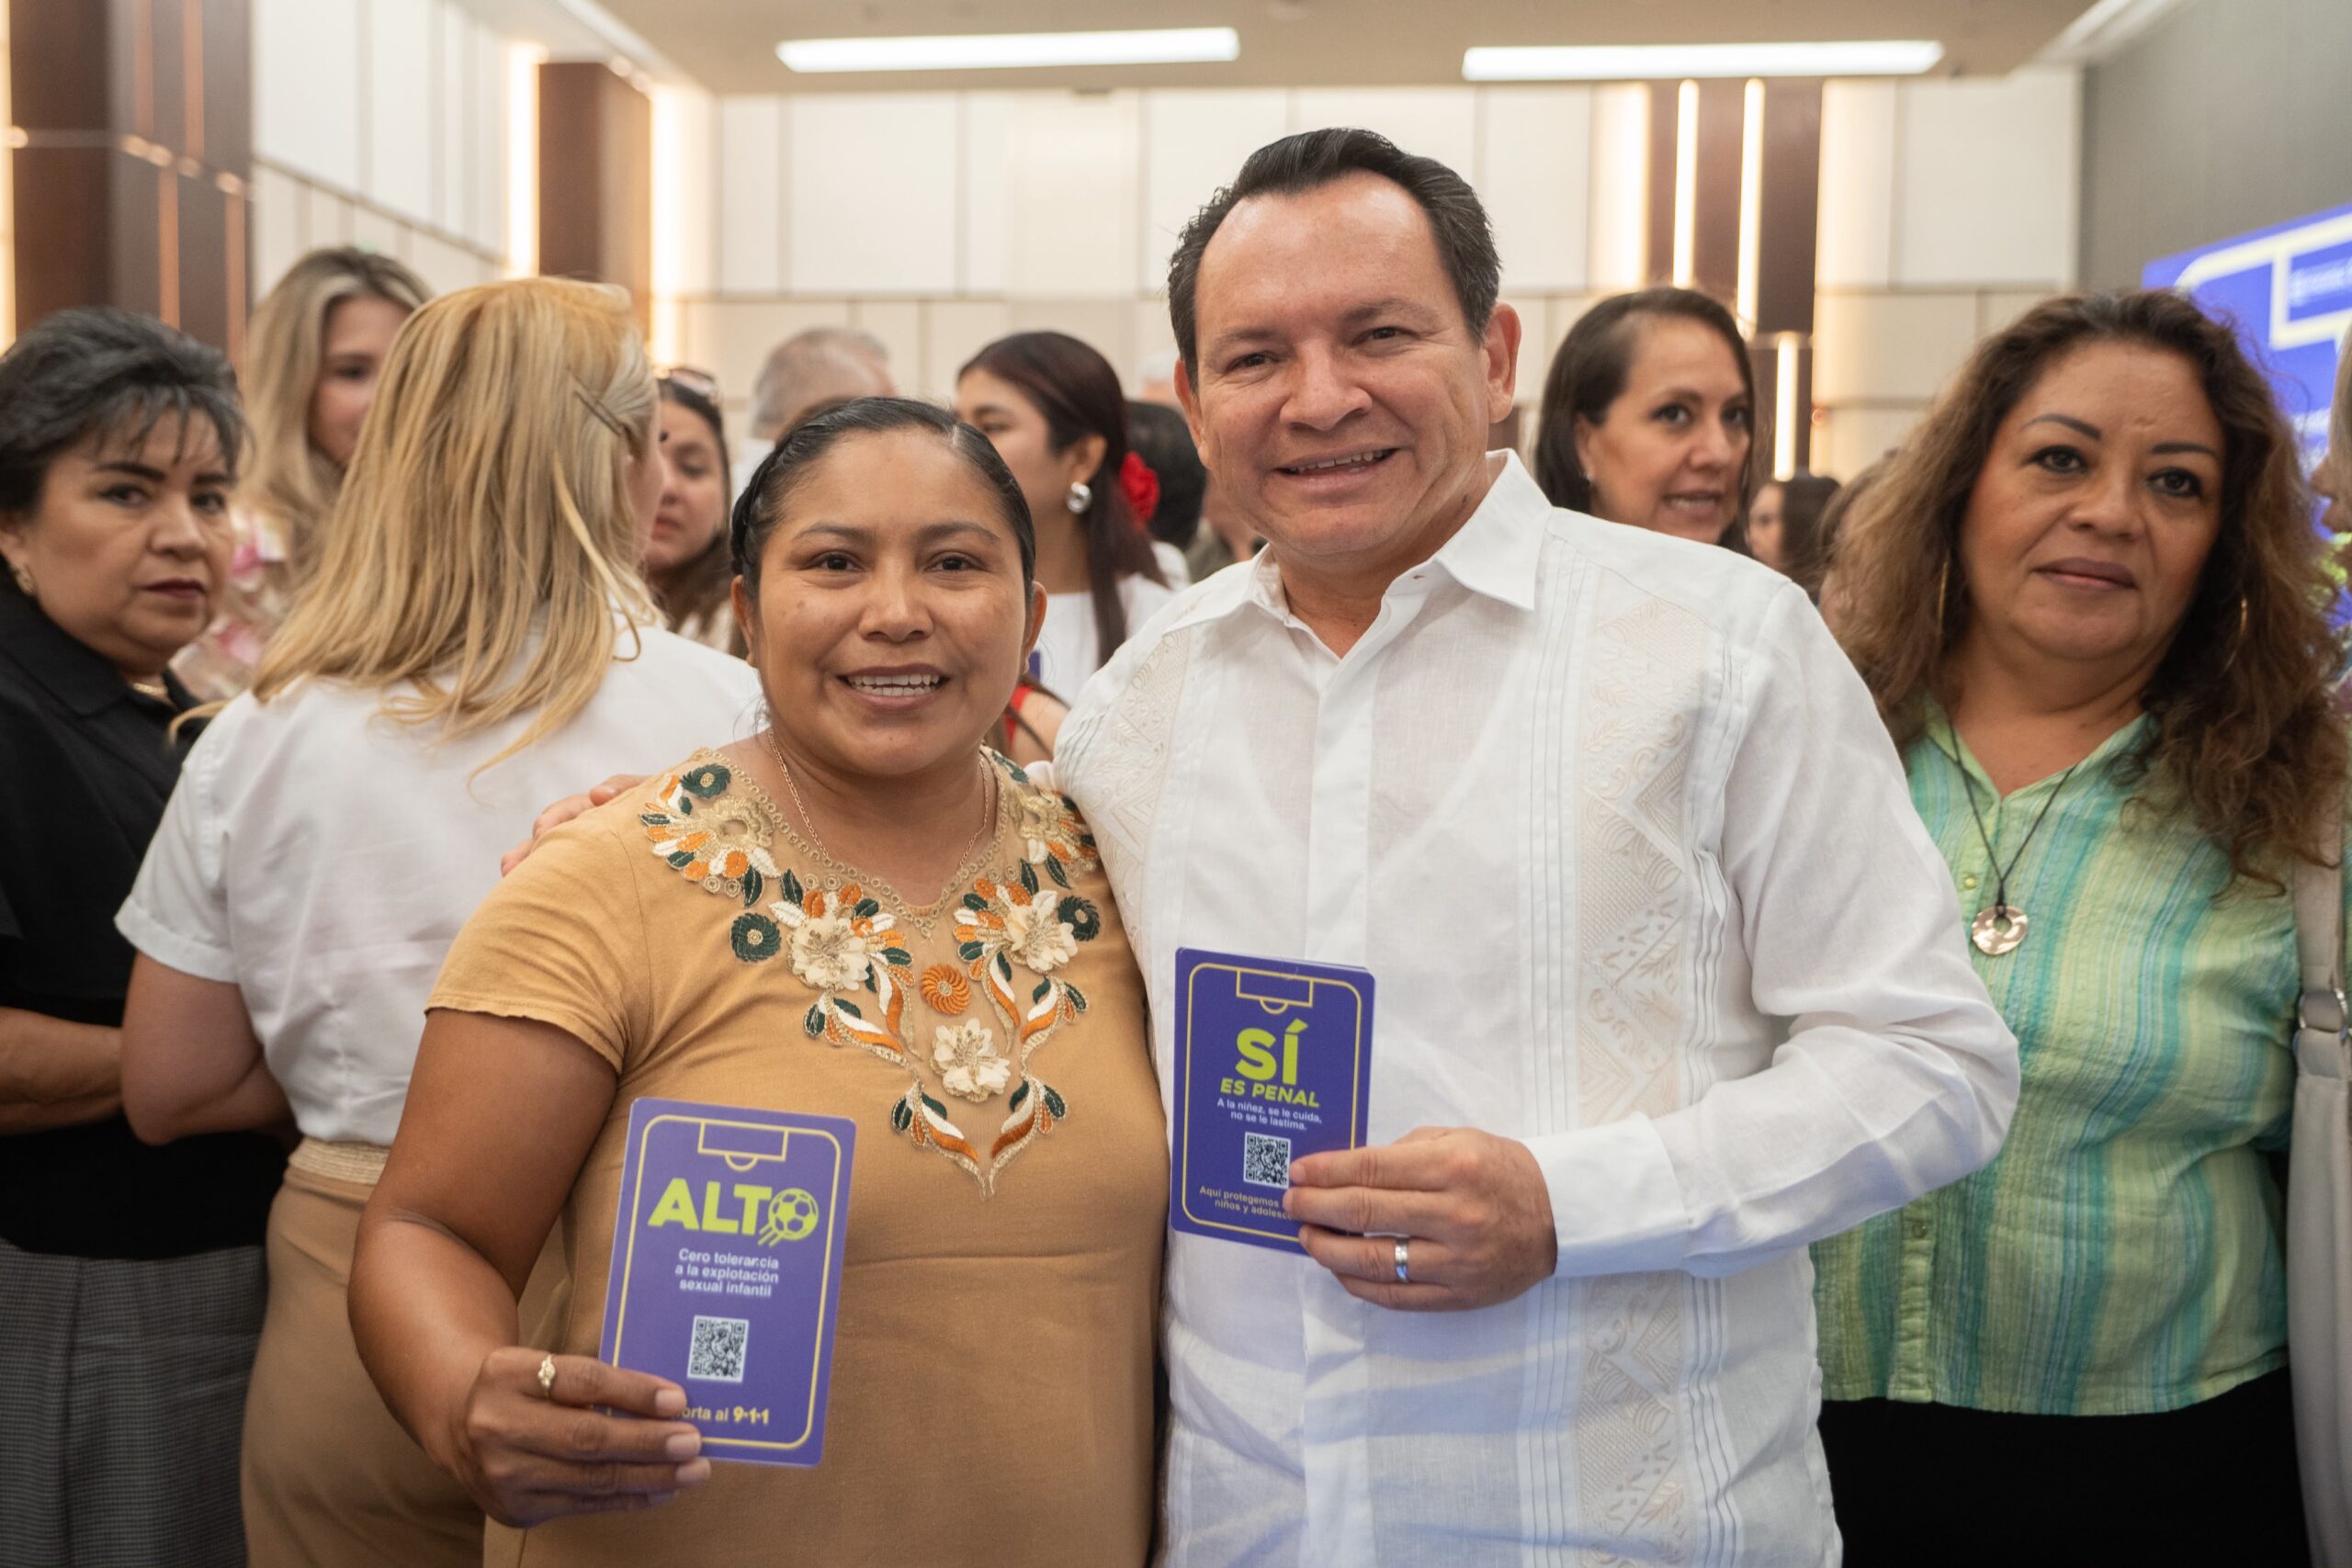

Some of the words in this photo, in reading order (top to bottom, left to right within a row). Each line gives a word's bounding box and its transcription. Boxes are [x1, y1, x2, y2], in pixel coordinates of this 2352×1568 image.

[1236, 1018, 1308, 1085] SÍ
[1220, 1077, 1246, 1096] ES
[1251, 1082, 1320, 1108] PENAL
[1217, 1098, 1225, 1108] A
[1227, 1099, 1236, 1110] la
[1268, 1107, 1280, 1116] se
[1282, 1107, 1291, 1118] le
[1230, 1111, 1243, 1120] no
[1245, 1112, 1257, 1122] se
[1259, 1114, 1268, 1125] le
[1215, 1199, 1240, 1211] niños
[1243, 1204, 1249, 1214] y
[1223, 1191, 1279, 1207] protegemos
[678, 1247, 711, 1264] Cero
[714, 1252, 780, 1269] tolerancia
[674, 1264, 684, 1276] a
[686, 1263, 699, 1277] la
[701, 1266, 780, 1284] explotación
[679, 1279, 723, 1293] sexual
[726, 1280, 773, 1298] infantil
[682, 1405, 712, 1421] orta
[715, 1406, 729, 1422] al
